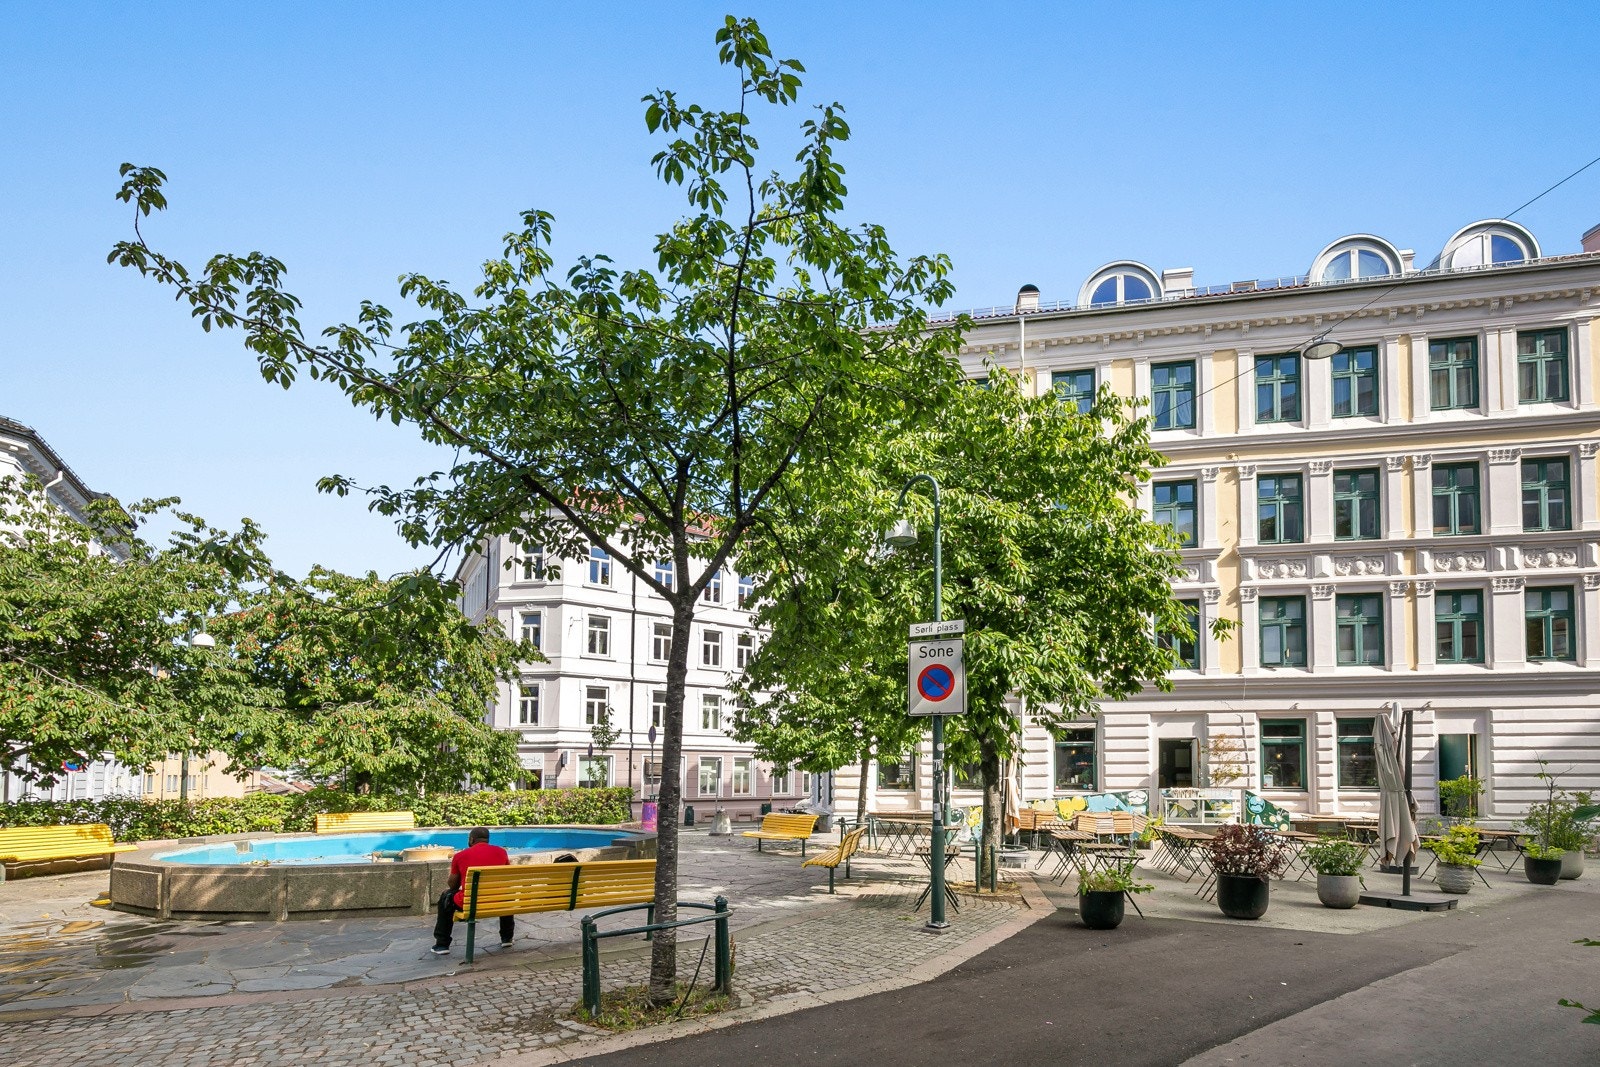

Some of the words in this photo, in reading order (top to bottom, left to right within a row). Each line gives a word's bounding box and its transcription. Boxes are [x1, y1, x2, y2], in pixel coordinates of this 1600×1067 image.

[915, 625, 933, 634] Sørli
[936, 624, 959, 633] plass
[919, 646, 954, 658] Sone
